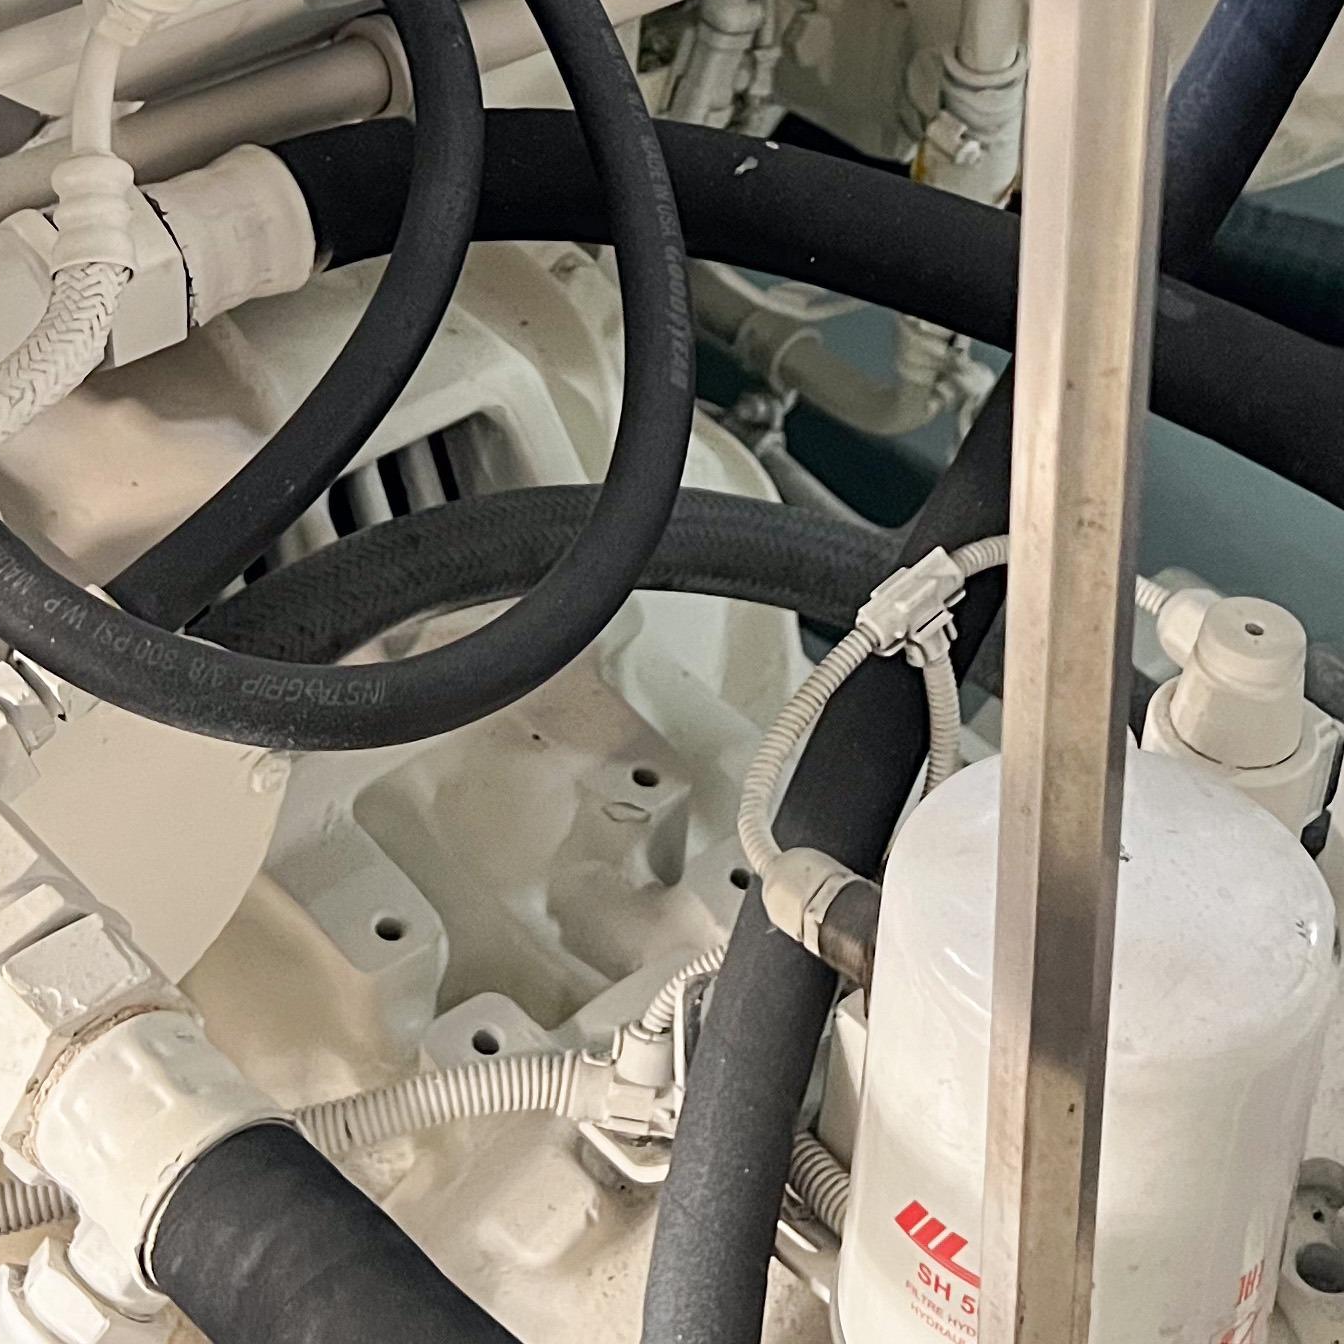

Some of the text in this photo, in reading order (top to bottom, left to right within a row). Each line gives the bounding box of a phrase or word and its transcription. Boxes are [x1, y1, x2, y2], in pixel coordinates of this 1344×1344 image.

[652, 183, 671, 201] IN
[663, 244, 689, 391] GOODYEAR
[92, 617, 135, 652] PSI
[905, 1279, 977, 1338] FILTRE HYD
[917, 1262, 976, 1314] SH 5
